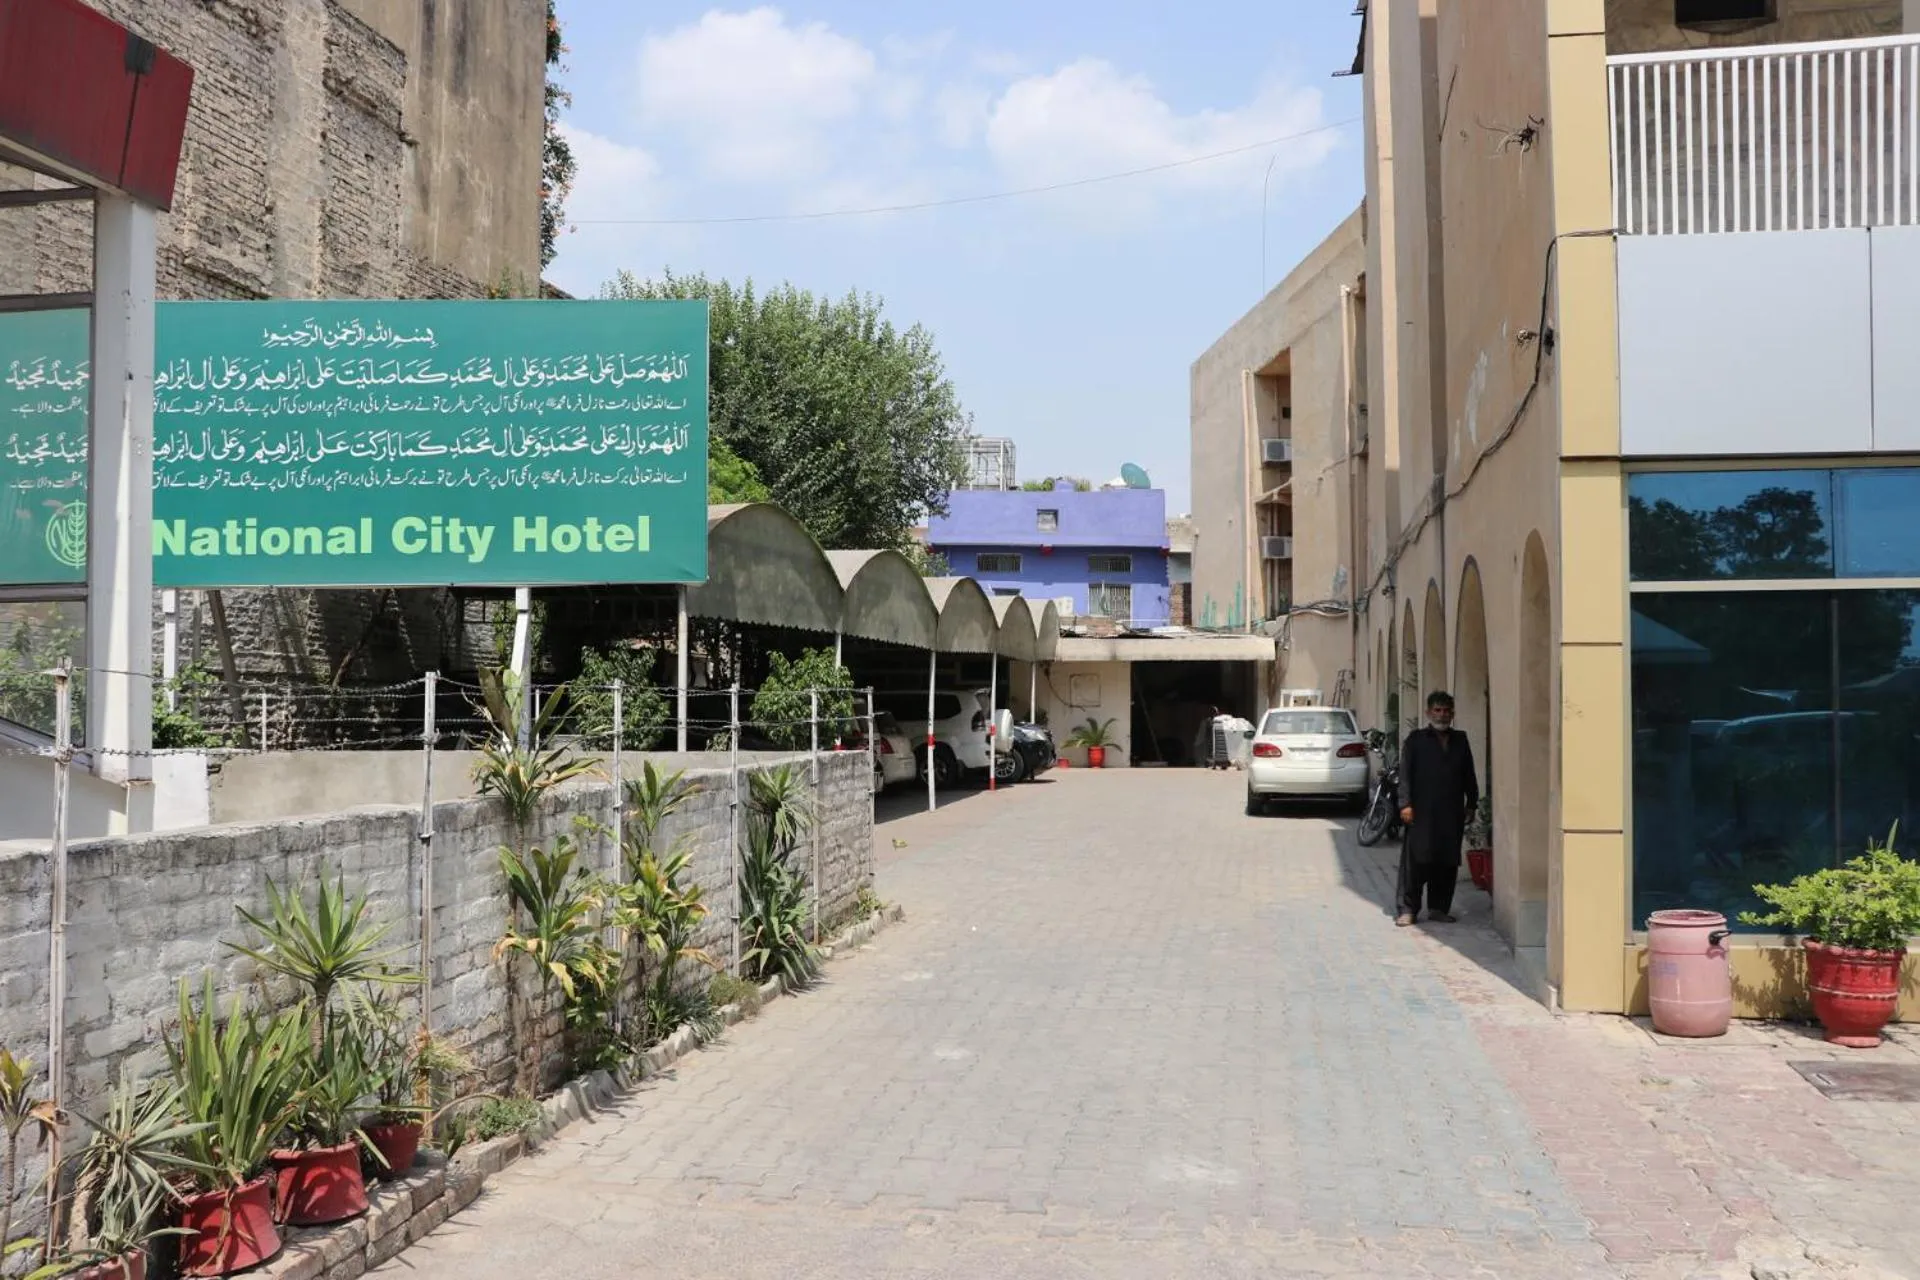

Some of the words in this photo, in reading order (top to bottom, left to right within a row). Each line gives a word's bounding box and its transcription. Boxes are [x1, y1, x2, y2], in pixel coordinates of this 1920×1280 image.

[152, 517, 373, 556] National
[391, 516, 495, 563] City
[512, 515, 651, 553] Hotel
